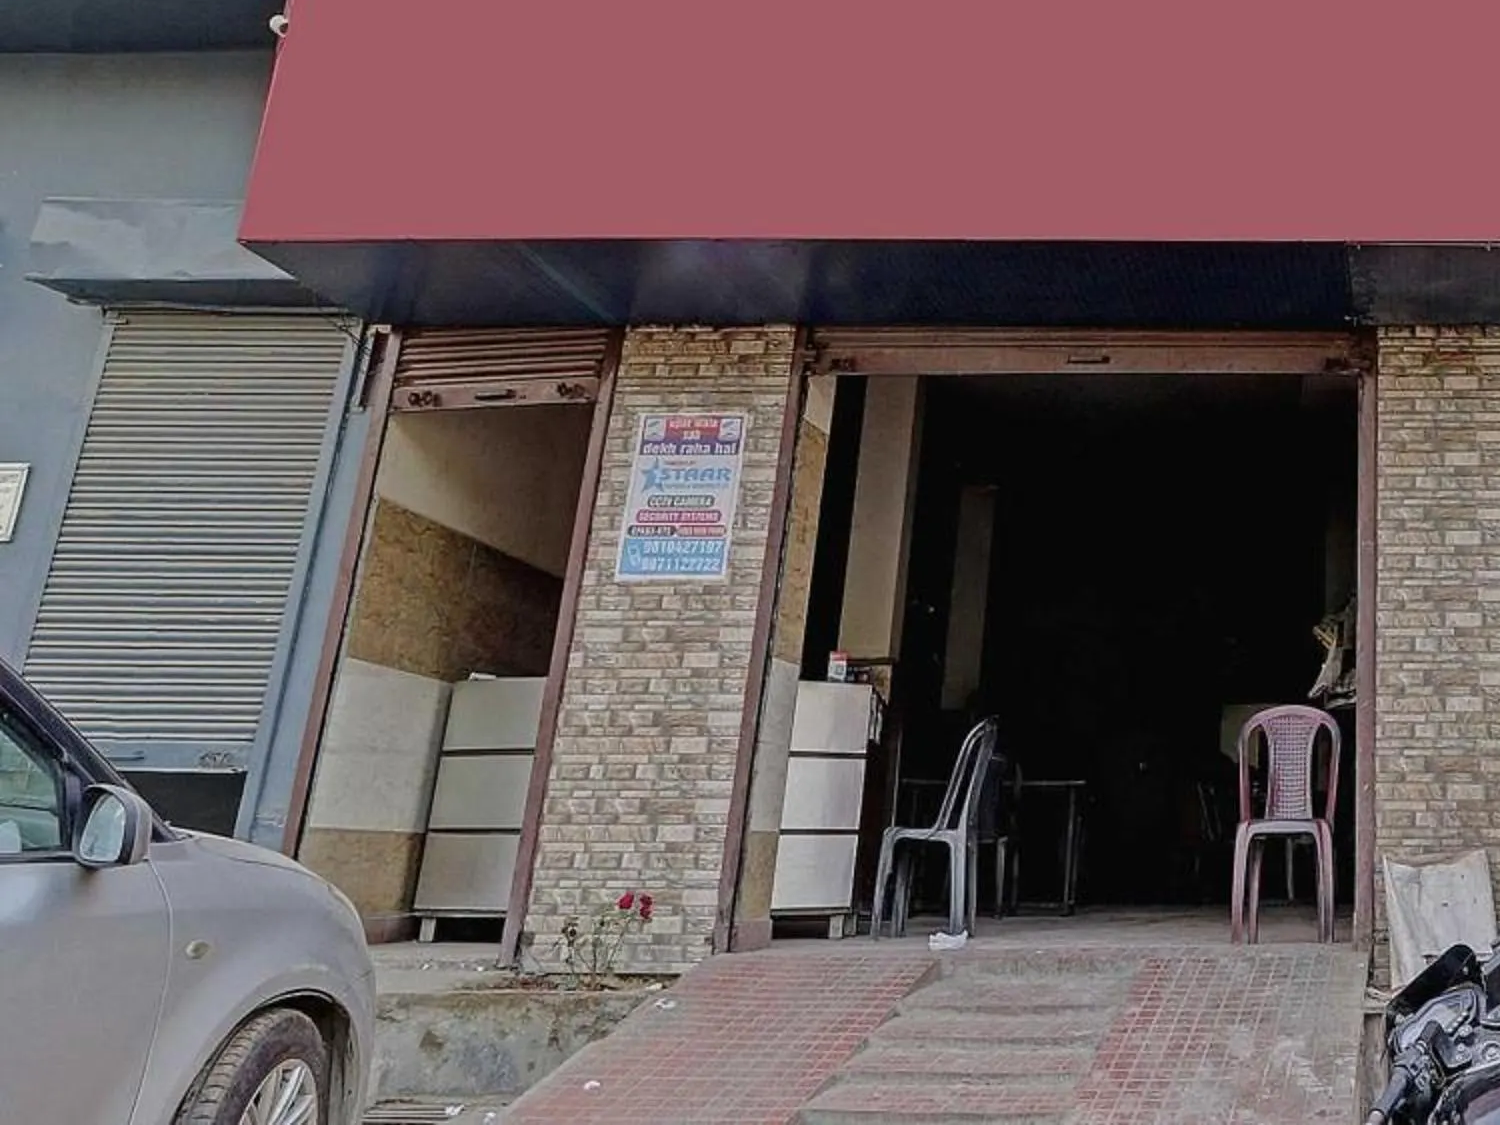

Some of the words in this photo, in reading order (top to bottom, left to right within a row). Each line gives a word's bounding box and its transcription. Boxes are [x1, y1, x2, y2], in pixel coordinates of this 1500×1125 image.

[643, 442, 677, 454] dekh
[679, 442, 711, 454] raha
[659, 467, 732, 481] STAAR
